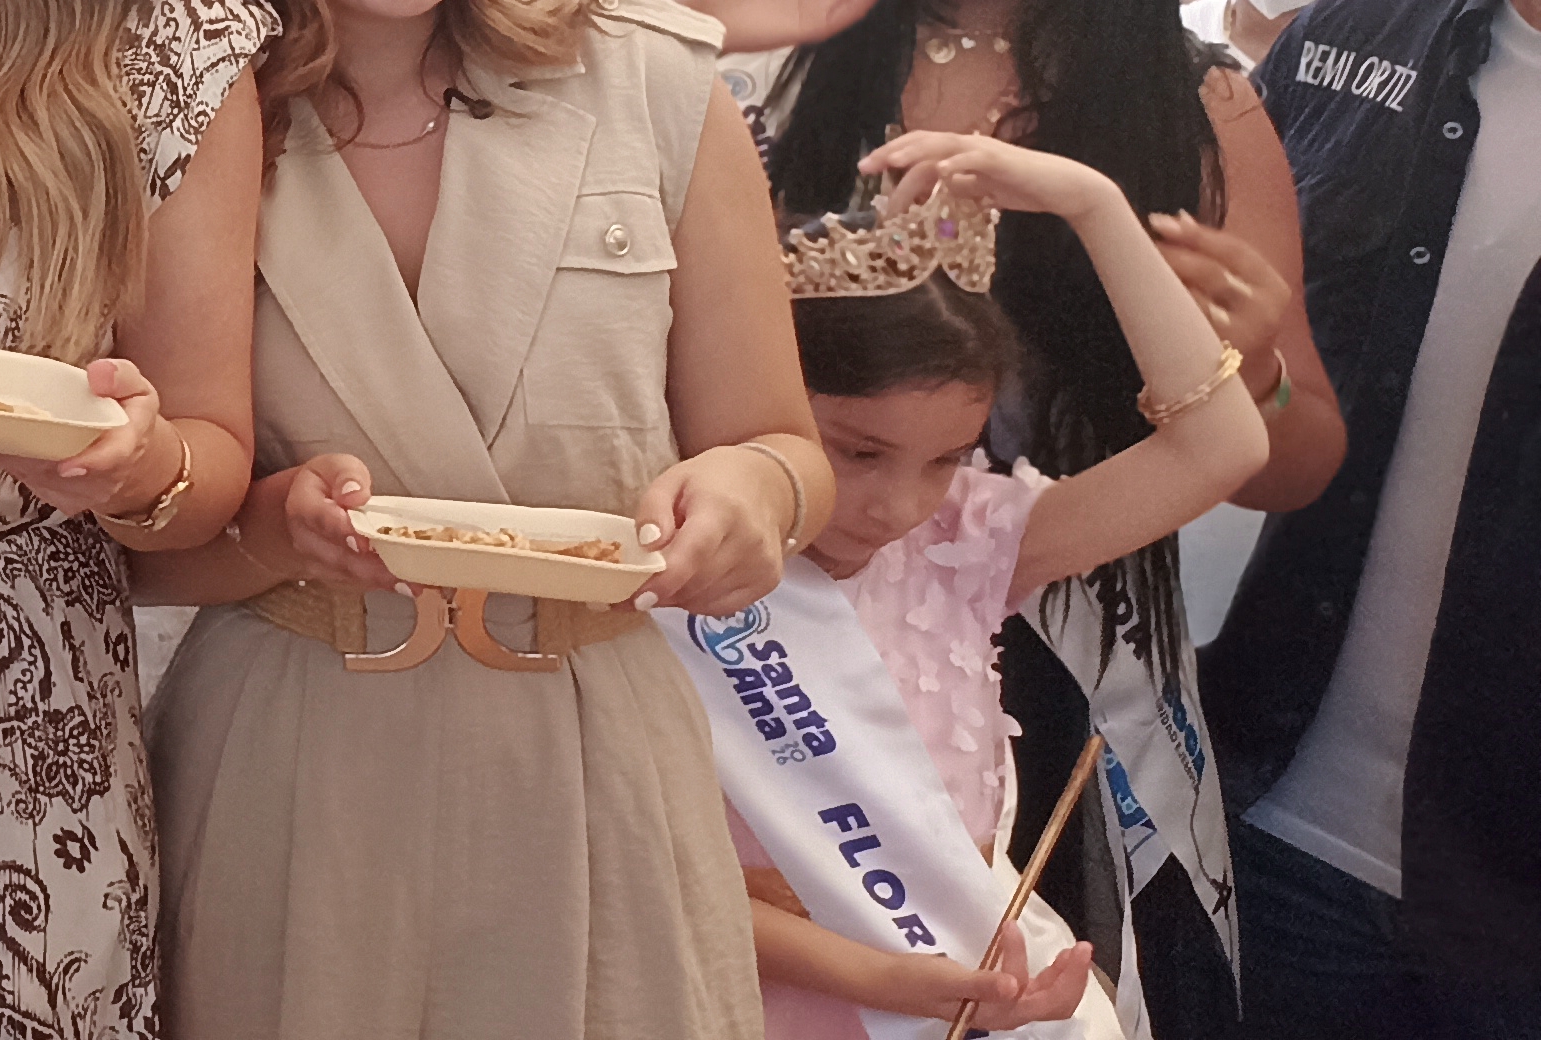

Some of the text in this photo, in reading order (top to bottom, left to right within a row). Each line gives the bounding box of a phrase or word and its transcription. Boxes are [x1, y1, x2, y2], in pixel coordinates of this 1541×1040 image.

[1295, 40, 1357, 92] REMI
[722, 666, 788, 743] Ana
[746, 639, 837, 758] Santa
[817, 802, 937, 949] FLOR
